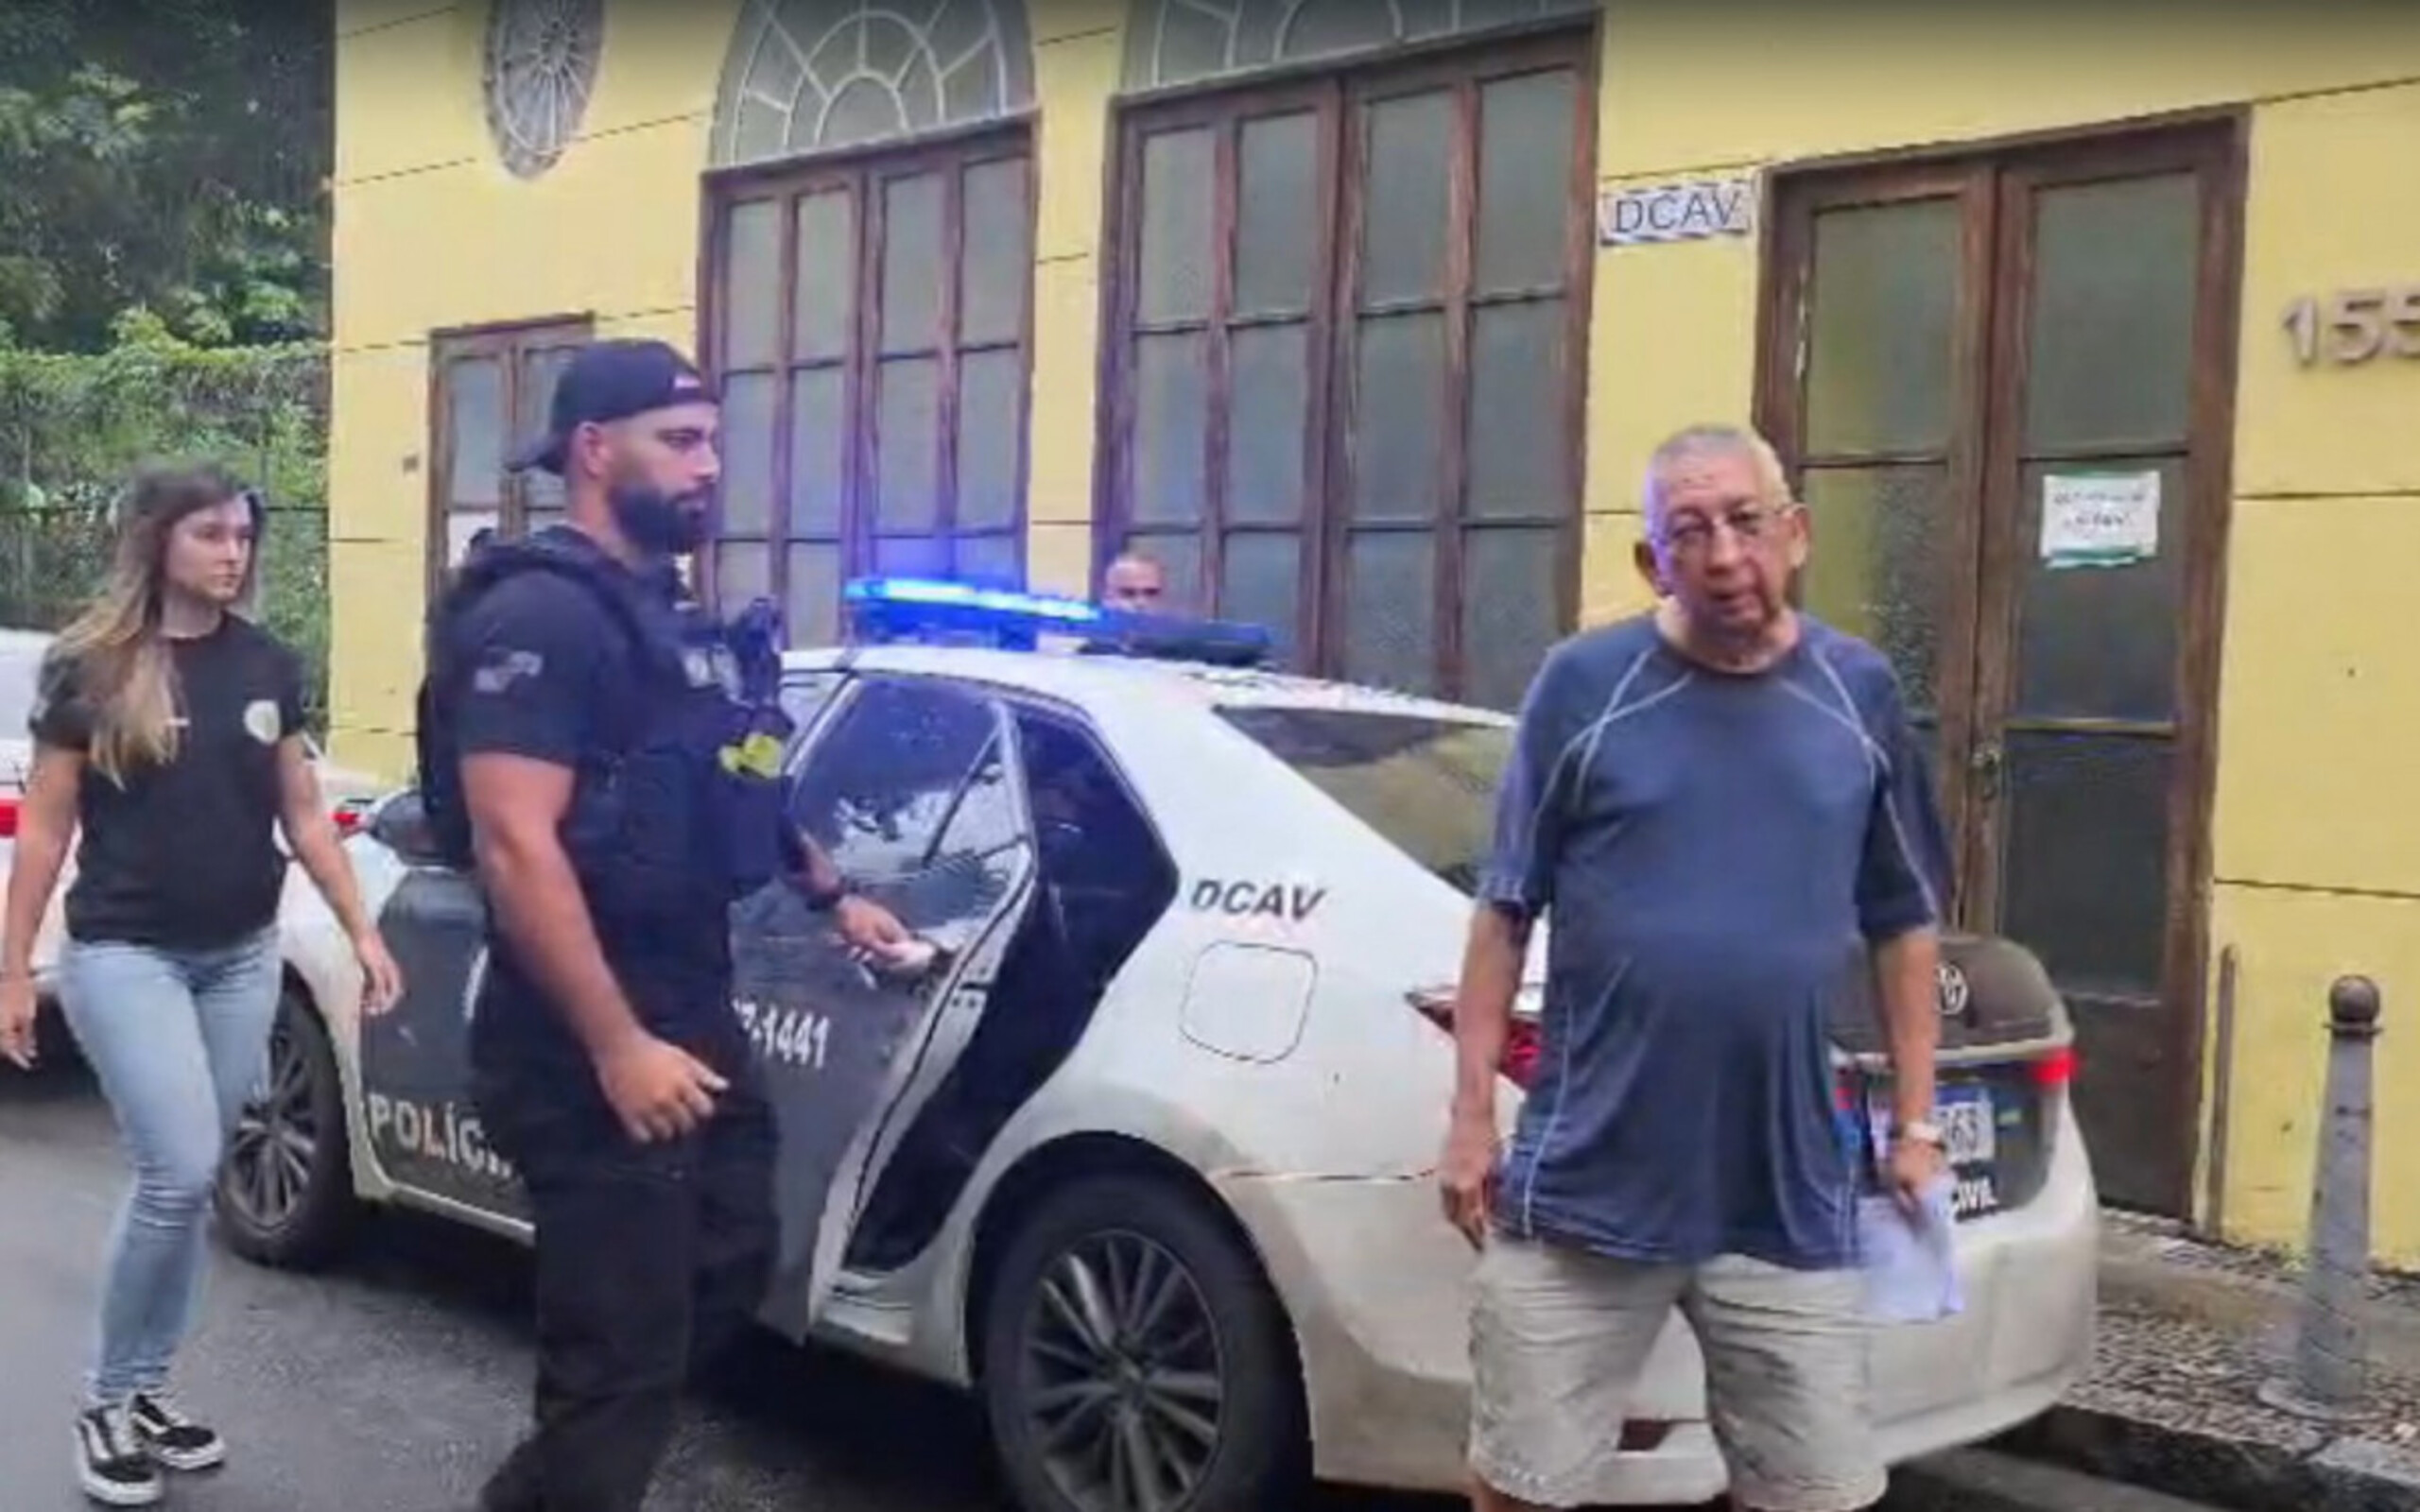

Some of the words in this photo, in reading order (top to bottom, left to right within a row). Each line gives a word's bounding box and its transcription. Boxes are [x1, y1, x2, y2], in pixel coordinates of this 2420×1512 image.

[1615, 190, 1740, 233] DCAV
[1191, 879, 1326, 921] DCAV
[370, 1092, 524, 1183] POLÍC
